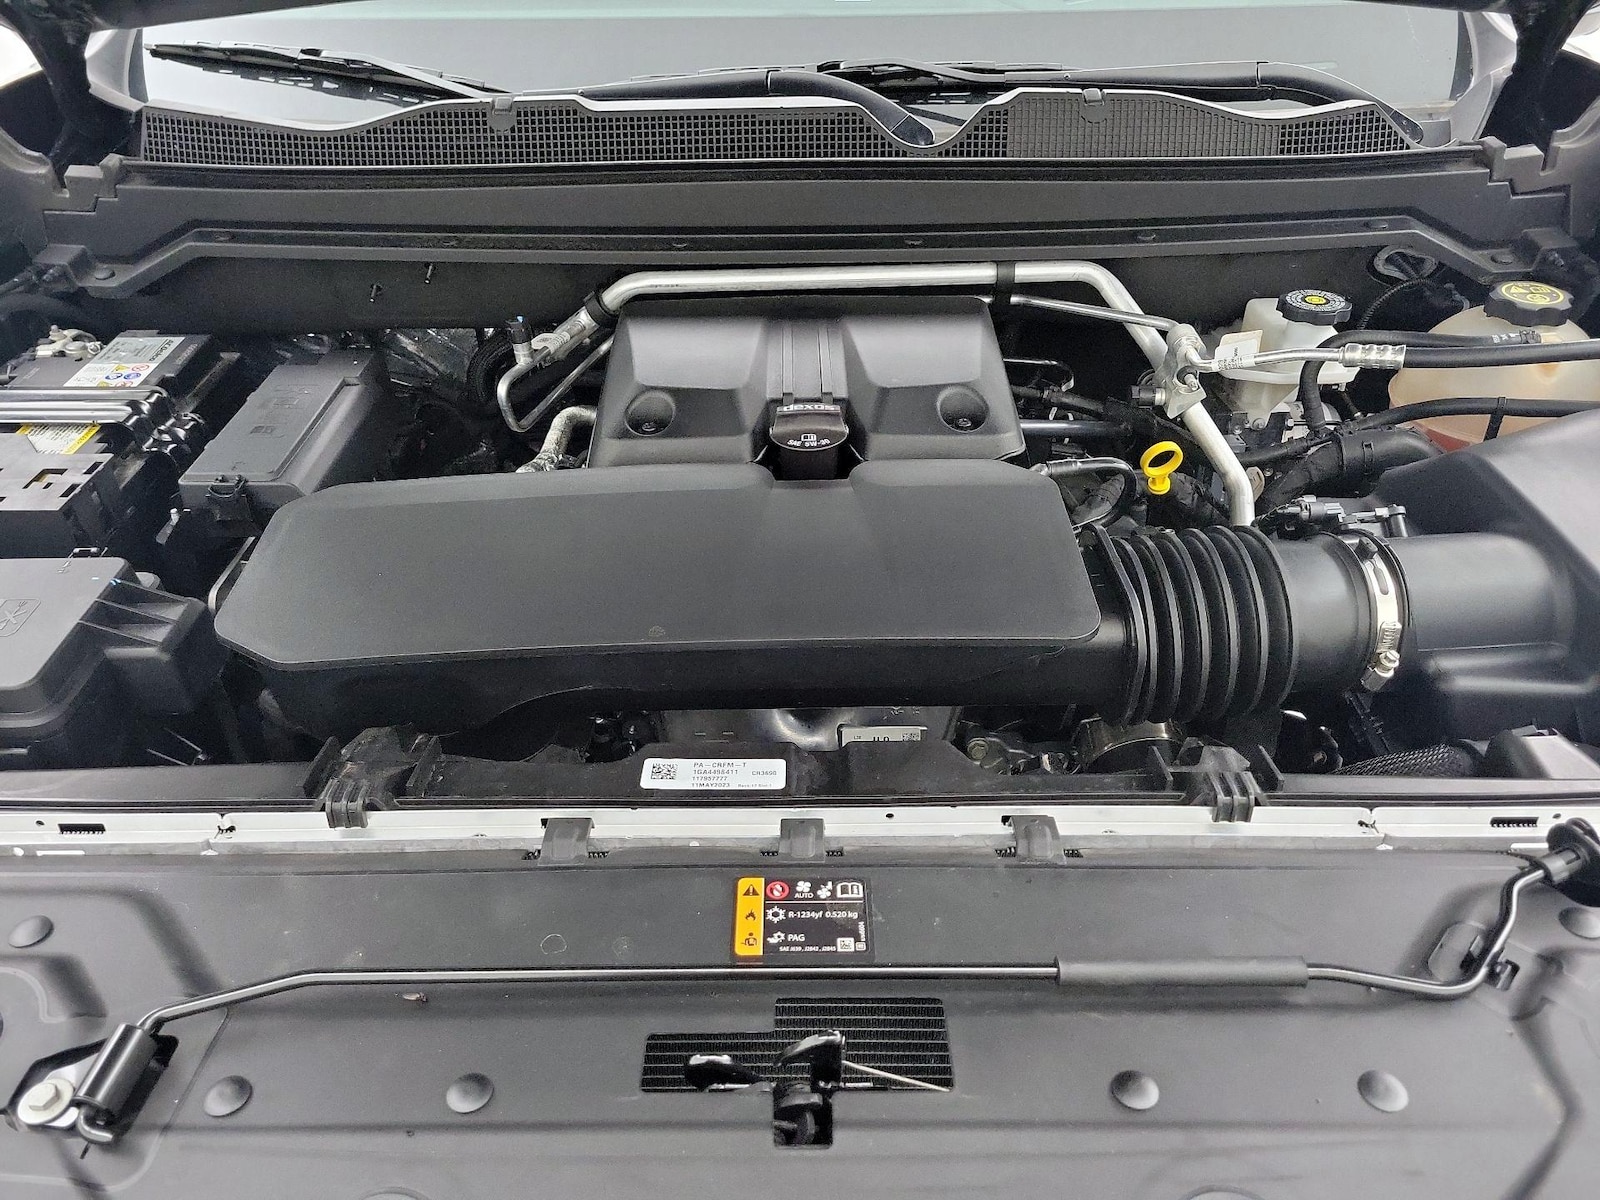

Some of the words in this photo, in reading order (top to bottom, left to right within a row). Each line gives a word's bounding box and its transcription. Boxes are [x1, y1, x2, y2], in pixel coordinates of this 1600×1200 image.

[787, 439, 802, 447] SAE
[804, 438, 831, 447] 5W-30
[788, 911, 823, 919] R-1234yf
[848, 911, 859, 919] kg
[787, 934, 806, 942] PAG
